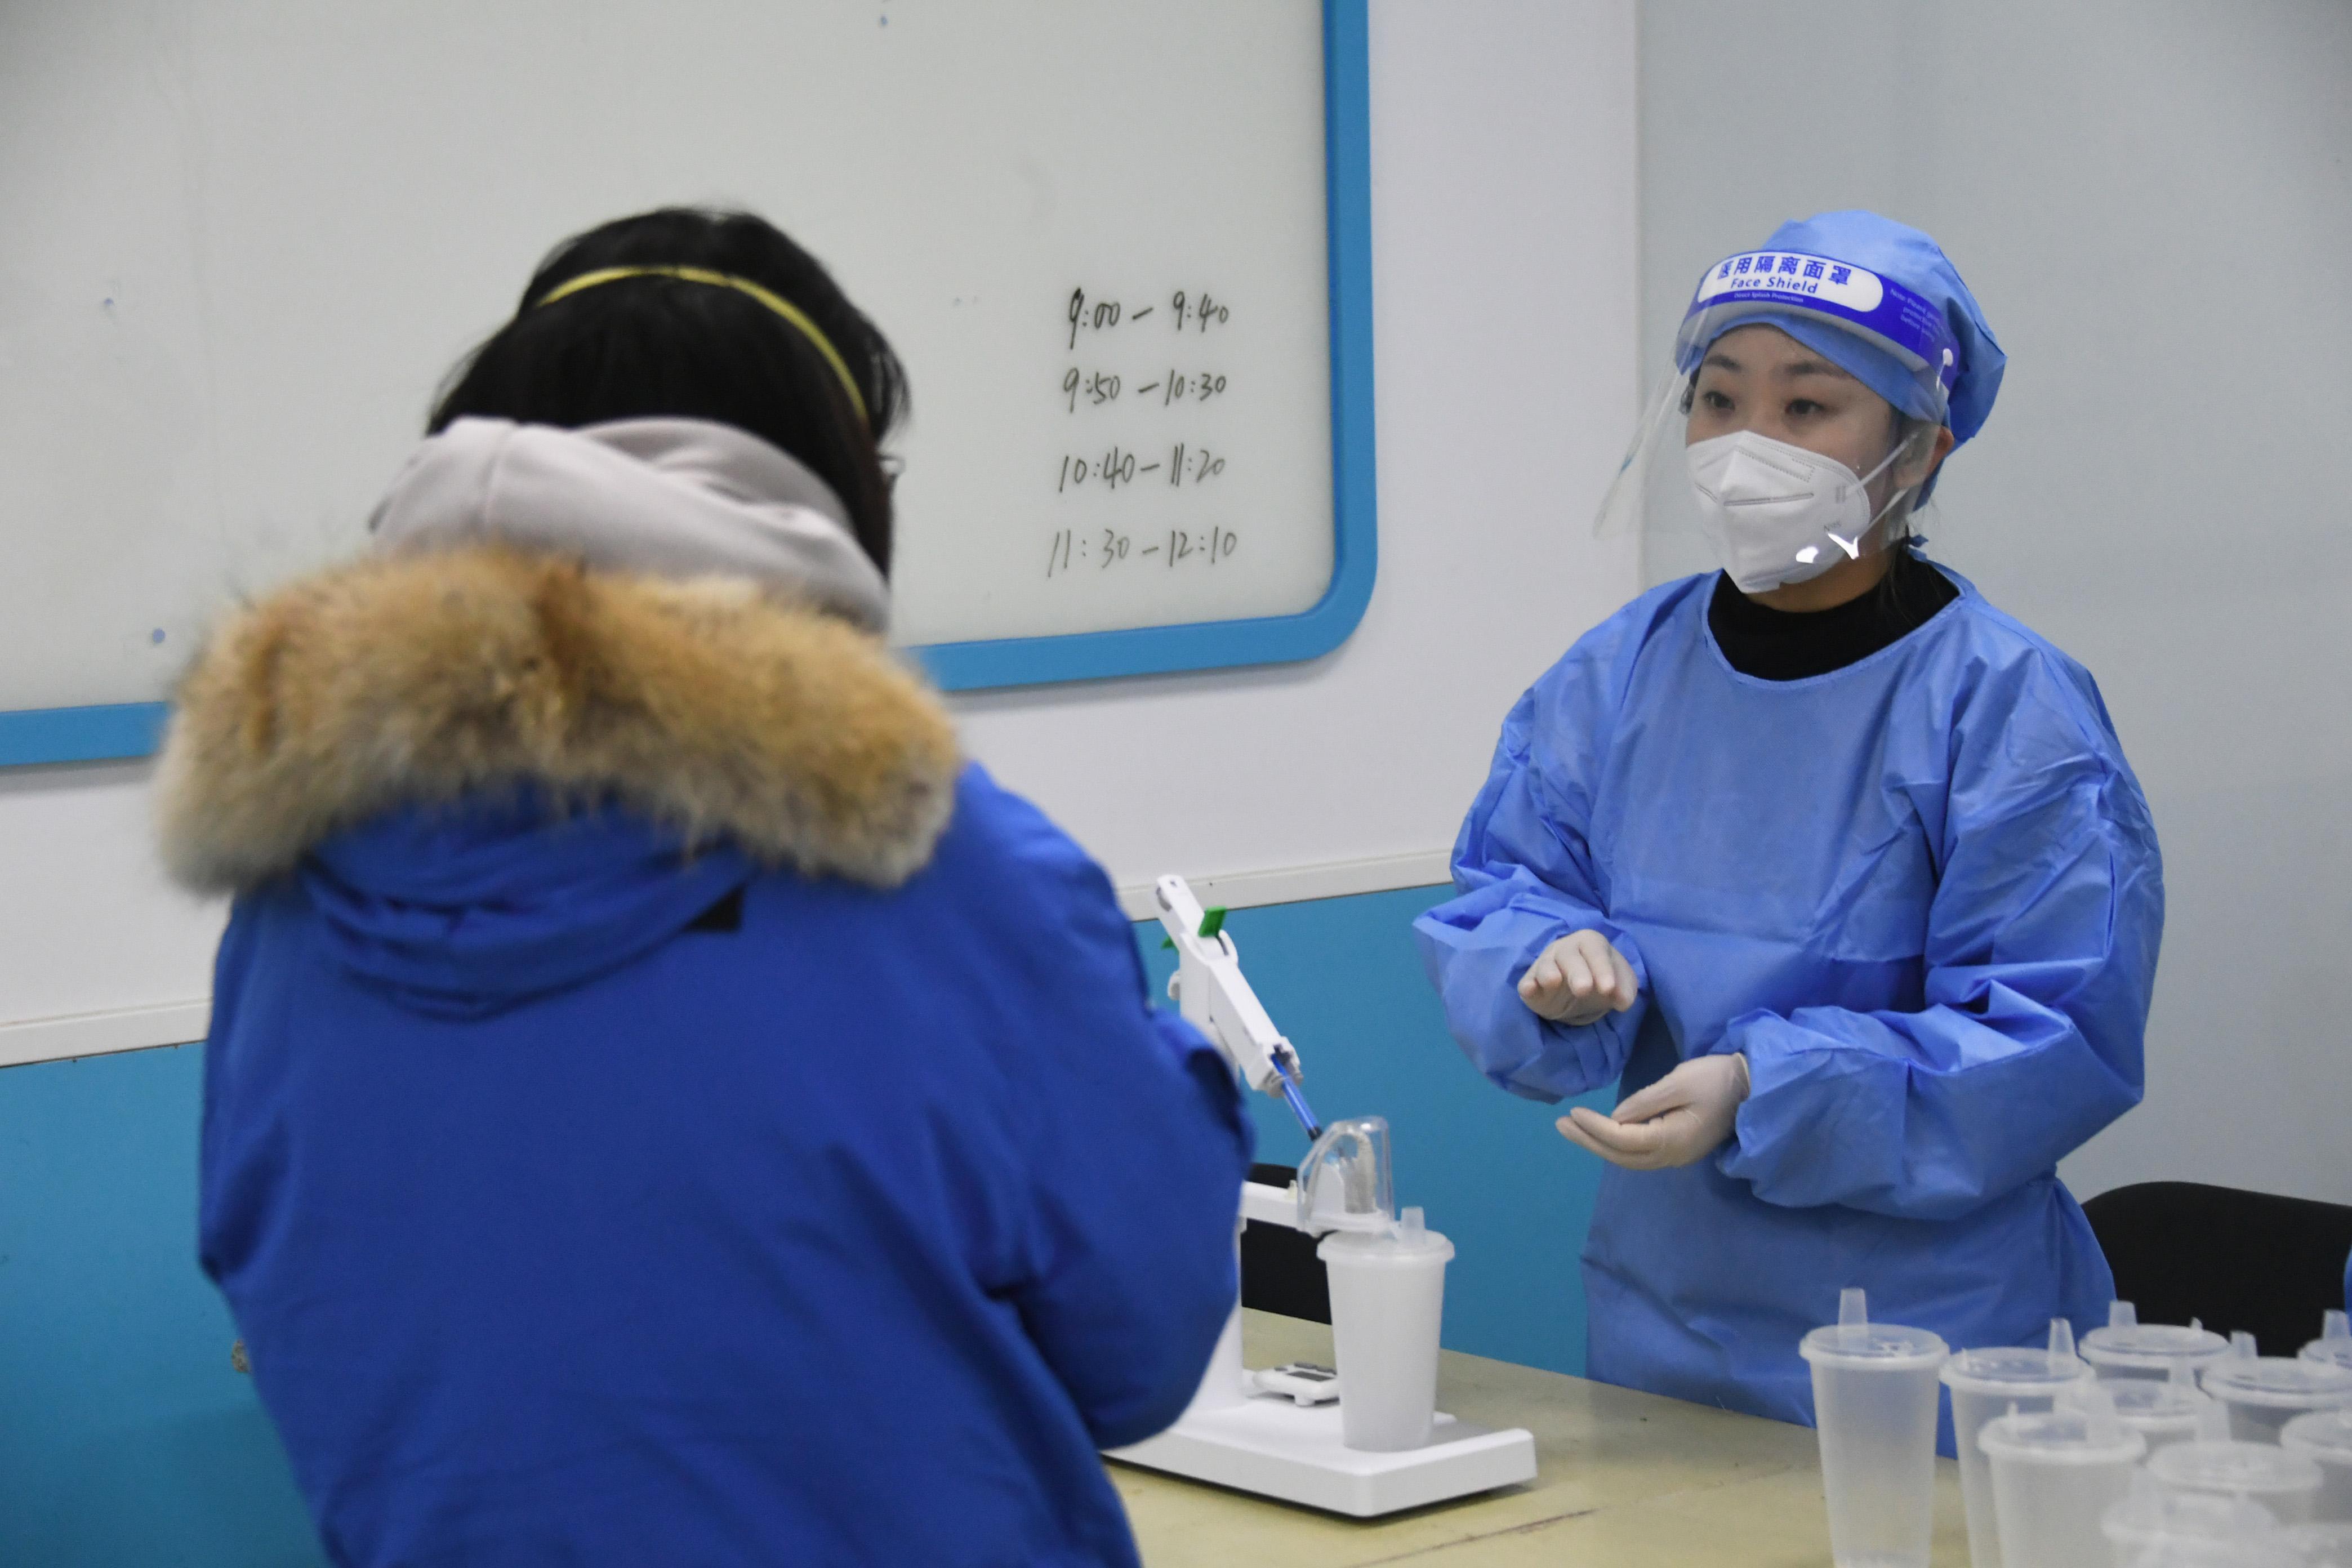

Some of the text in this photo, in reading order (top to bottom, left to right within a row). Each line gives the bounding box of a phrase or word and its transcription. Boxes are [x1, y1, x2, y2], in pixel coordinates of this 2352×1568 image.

[1731, 277, 1818, 294] Face Shield
[1070, 287, 1121, 350] 9:00
[1173, 291, 1229, 332] 9:40
[1064, 367, 1121, 413] 9:50
[1165, 369, 1226, 406] 10:30
[1059, 446, 1135, 493] 10:40
[1171, 442, 1226, 487] 11:20
[1048, 528, 1130, 578] 11:30
[1169, 525, 1237, 568] 12:10
